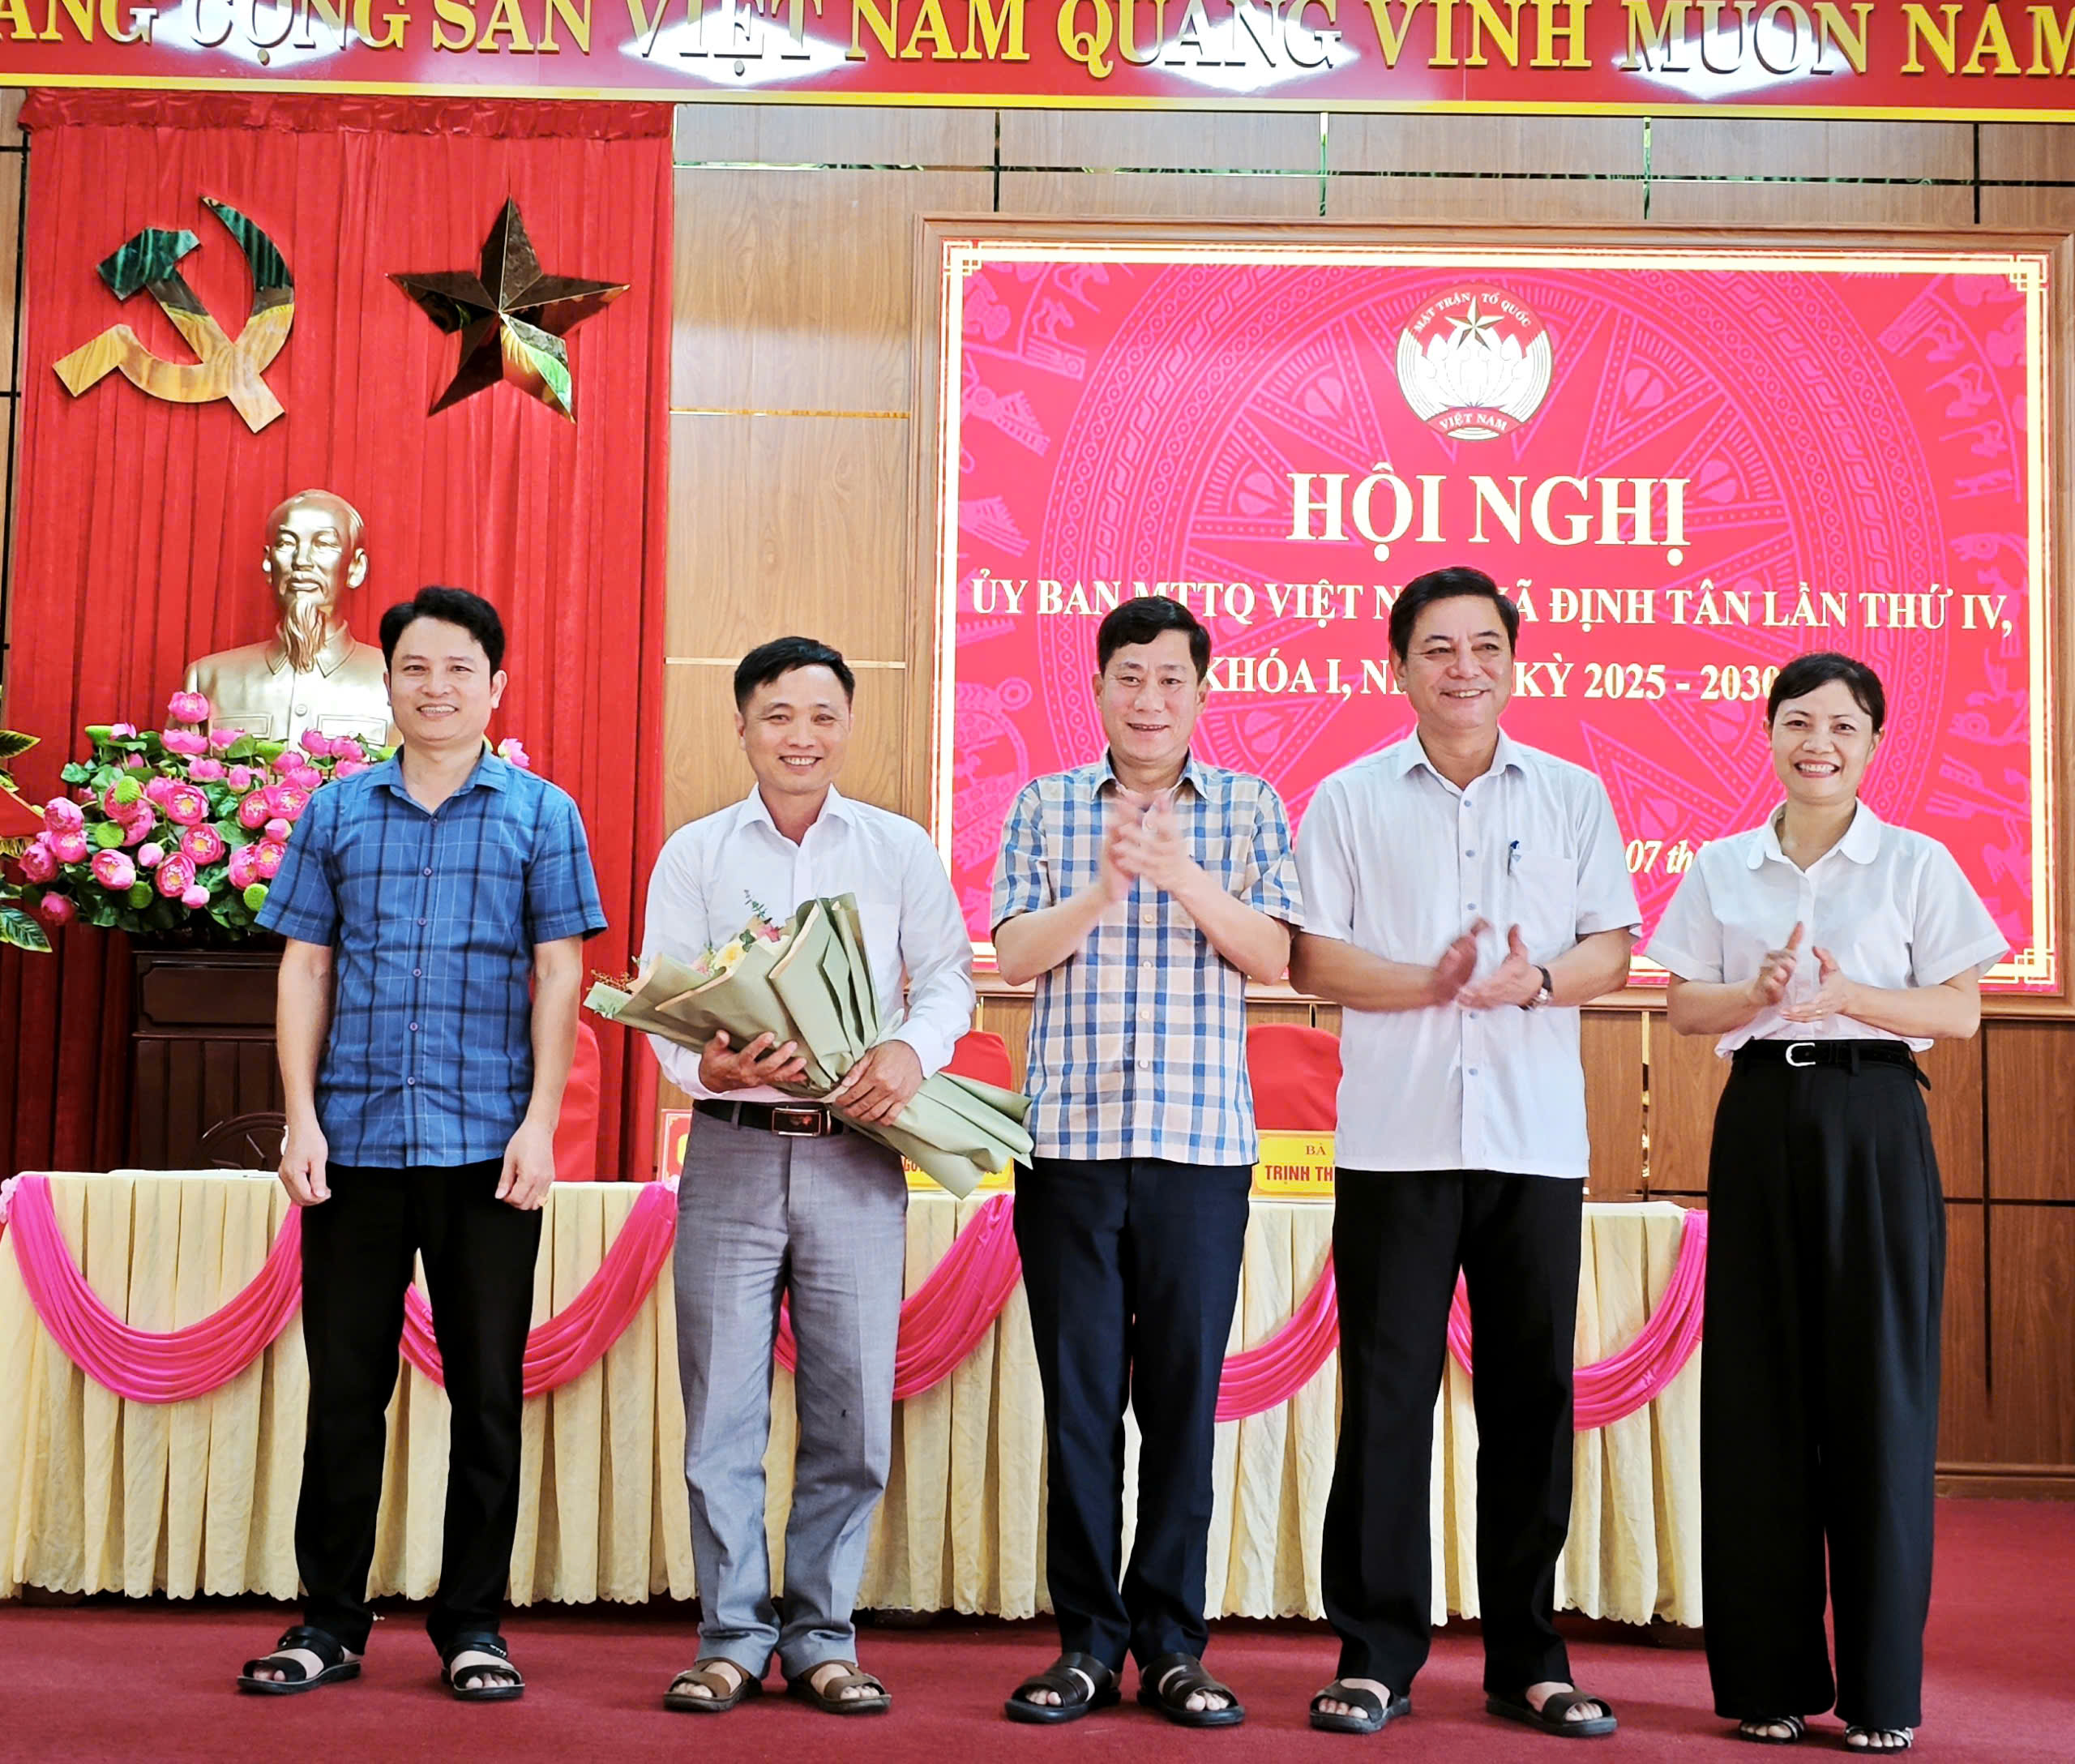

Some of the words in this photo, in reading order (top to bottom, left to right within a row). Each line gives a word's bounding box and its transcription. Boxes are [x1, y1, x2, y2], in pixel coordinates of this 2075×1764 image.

[845, 0, 1030, 61] NAM
[1057, 0, 1342, 79] QUANG
[1477, 413, 1507, 431] NAM
[1286, 461, 1447, 562] HỘI
[1468, 475, 1692, 567] NGHỊ
[972, 568, 1028, 614] ỦY
[1037, 580, 1122, 615] BAN
[1264, 578, 1363, 628] VIỆT
[1497, 578, 1539, 623] Ã
[1549, 587, 1656, 632] ĐỊNH
[1666, 578, 1752, 626] TÂN
[1762, 581, 1848, 627] LẦN
[1859, 583, 1953, 630] THỨ
[1961, 594, 2013, 638] IV,
[1206, 648, 1317, 693] KHÓA
[1325, 658, 1351, 701] I,
[1511, 653, 1574, 697] KỲ
[1583, 662, 1666, 700] 2025
[1624, 839, 1662, 874] 07
[1264, 1165, 1310, 1184] TRỊNH
